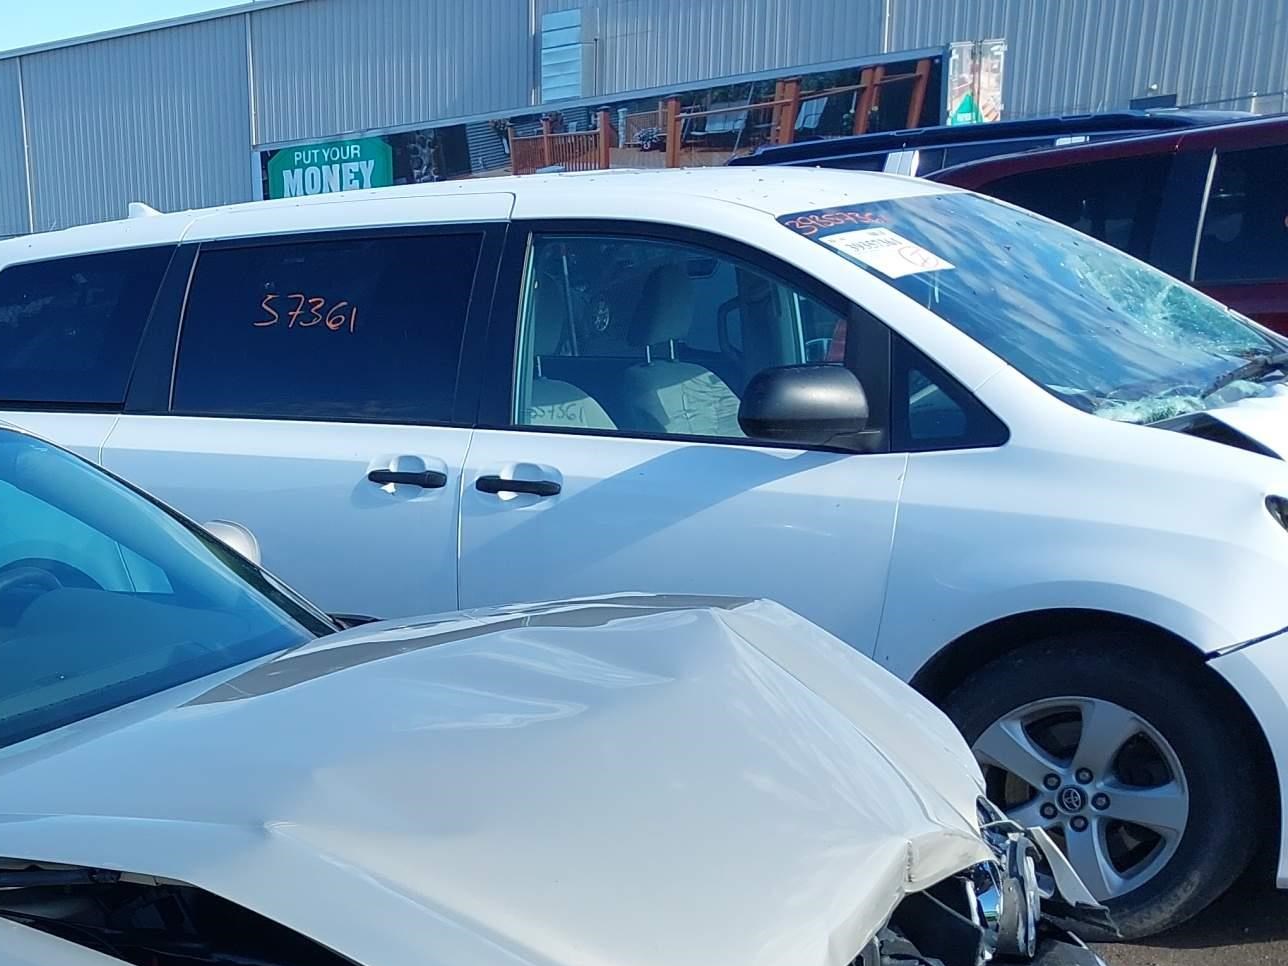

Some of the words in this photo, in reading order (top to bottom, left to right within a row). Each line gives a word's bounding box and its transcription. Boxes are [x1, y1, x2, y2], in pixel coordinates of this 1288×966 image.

[294, 149, 320, 165] PUT
[321, 144, 361, 162] YOUR
[282, 159, 375, 198] MONEY
[253, 293, 358, 333] 57361
